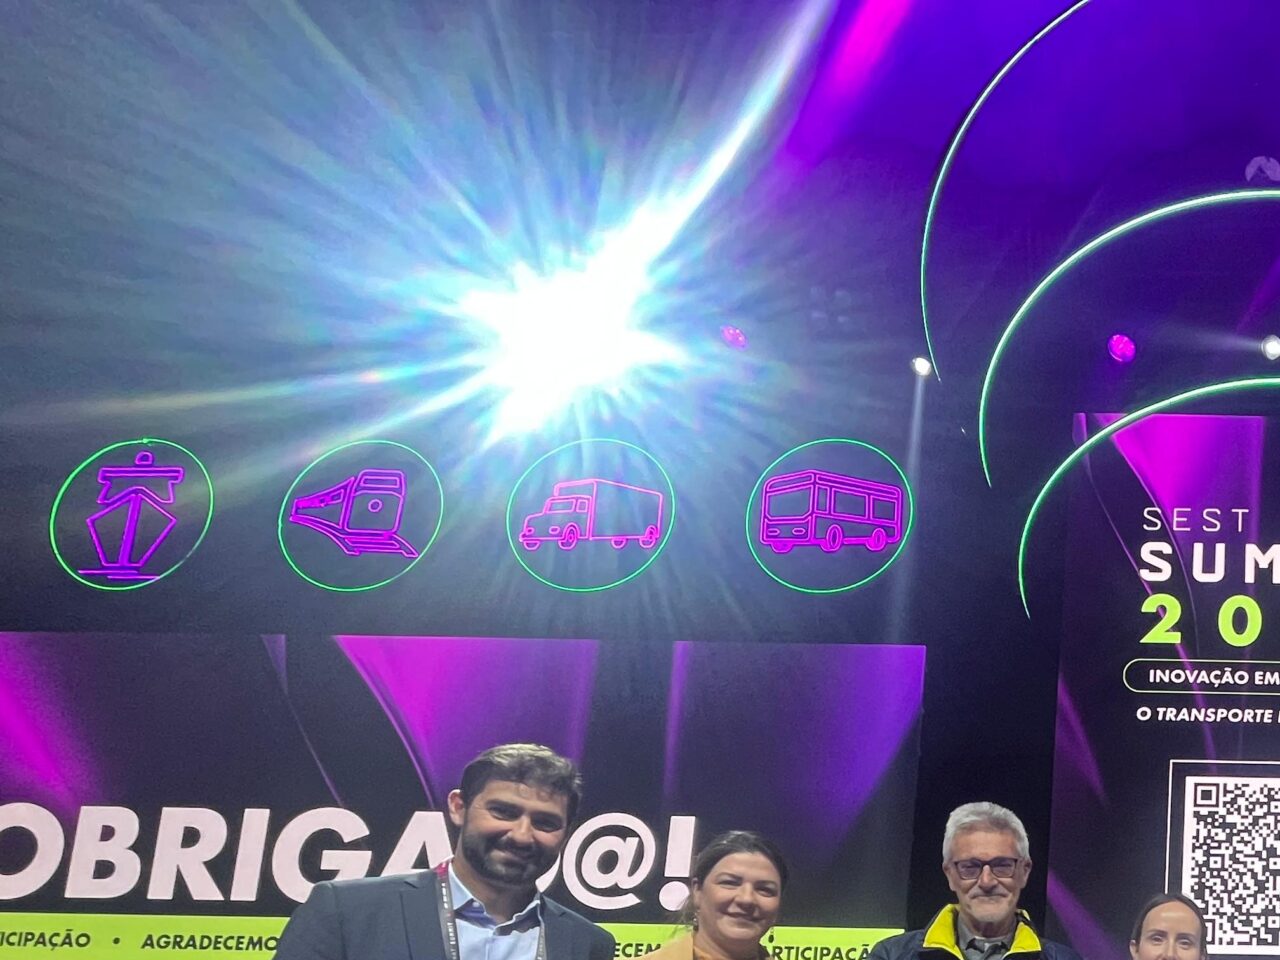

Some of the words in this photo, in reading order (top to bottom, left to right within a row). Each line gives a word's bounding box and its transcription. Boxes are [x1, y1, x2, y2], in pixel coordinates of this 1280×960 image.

[1142, 507, 1249, 533] SEST
[1149, 667, 1249, 688] INOVAÇÃO
[1254, 671, 1280, 687] EM
[1136, 706, 1152, 721] O
[1157, 707, 1273, 724] TRANSPORTE
[0, 802, 697, 911] OBRIGA@!
[0, 929, 91, 951] ICIPAÇÃO
